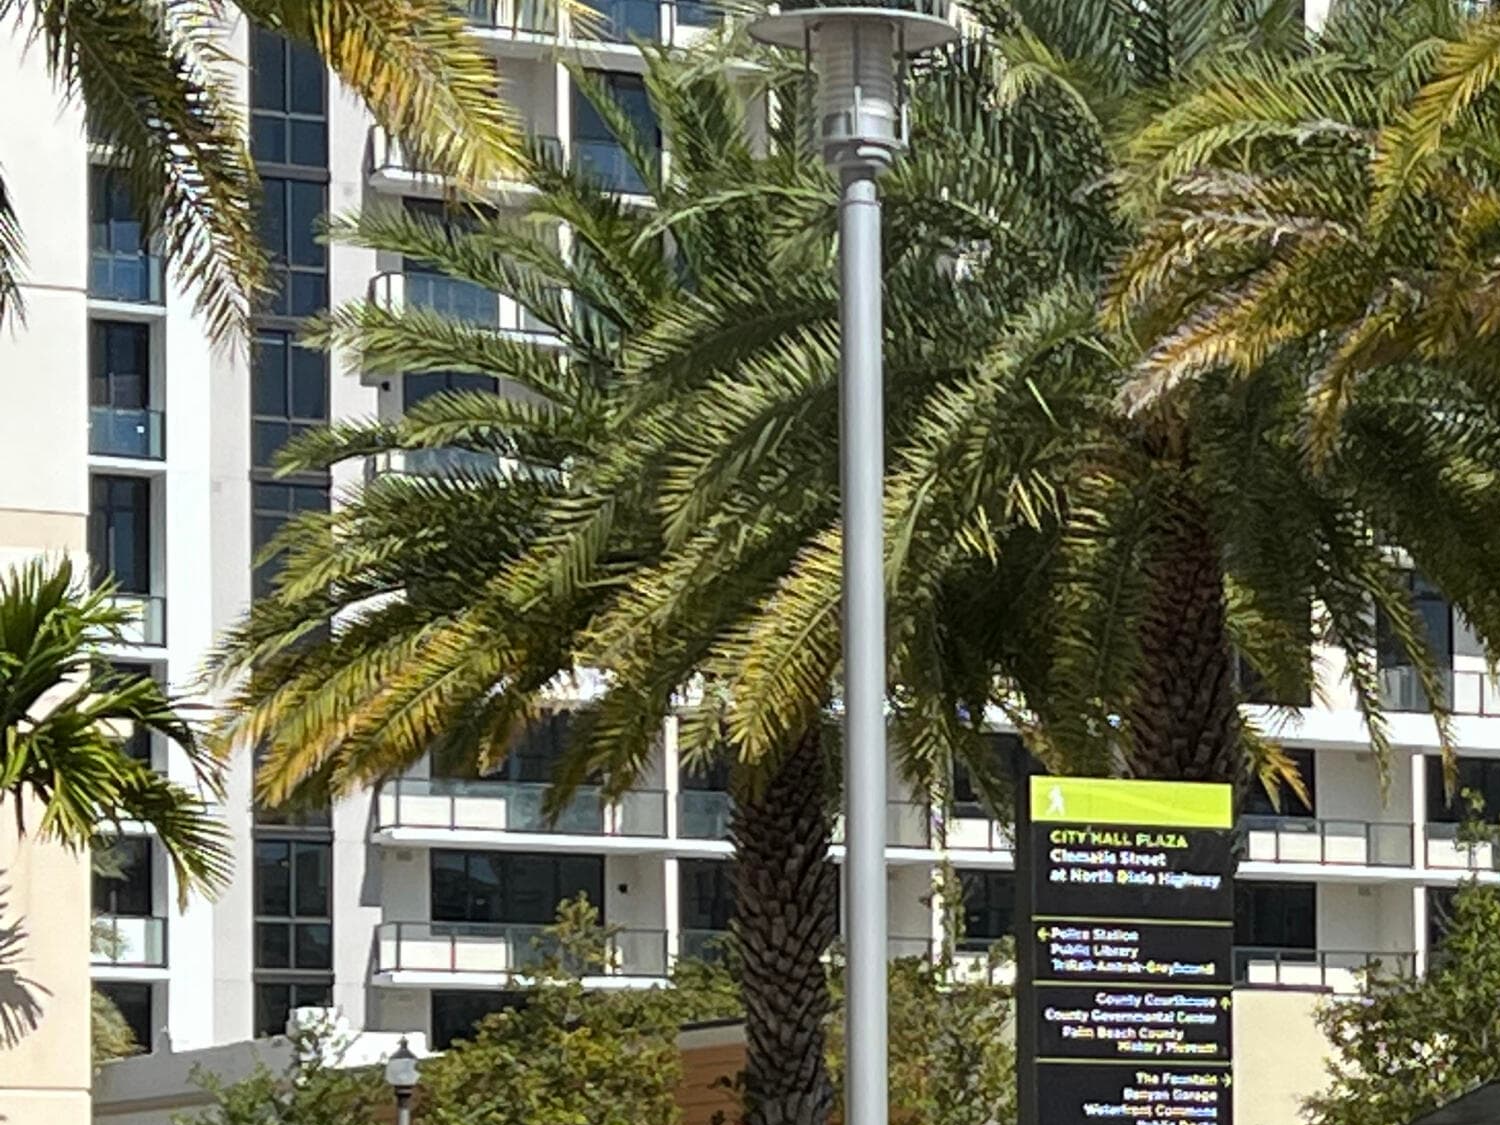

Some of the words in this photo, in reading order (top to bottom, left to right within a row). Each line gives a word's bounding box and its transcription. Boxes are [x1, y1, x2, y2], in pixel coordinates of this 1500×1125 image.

[1050, 830, 1088, 843] CITY
[1089, 832, 1132, 846] HALL
[1136, 833, 1188, 848] PLAZA
[1050, 849, 1117, 864] Clematis
[1120, 851, 1166, 866] Street
[1050, 868, 1067, 882] at
[1070, 868, 1114, 883] North
[1117, 870, 1155, 885] Dixie
[1158, 872, 1221, 889] Highway
[1050, 927, 1090, 940] Police
[1093, 929, 1138, 942] Station
[1093, 945, 1138, 959] Library
[1096, 993, 1142, 1007] County
[1045, 1008, 1089, 1023] County
[1062, 1026, 1095, 1038] Palm
[1097, 1026, 1136, 1041] Beach
[1138, 1027, 1184, 1042] County
[1136, 1072, 1159, 1084] The
[1173, 1089, 1218, 1103] Garage
